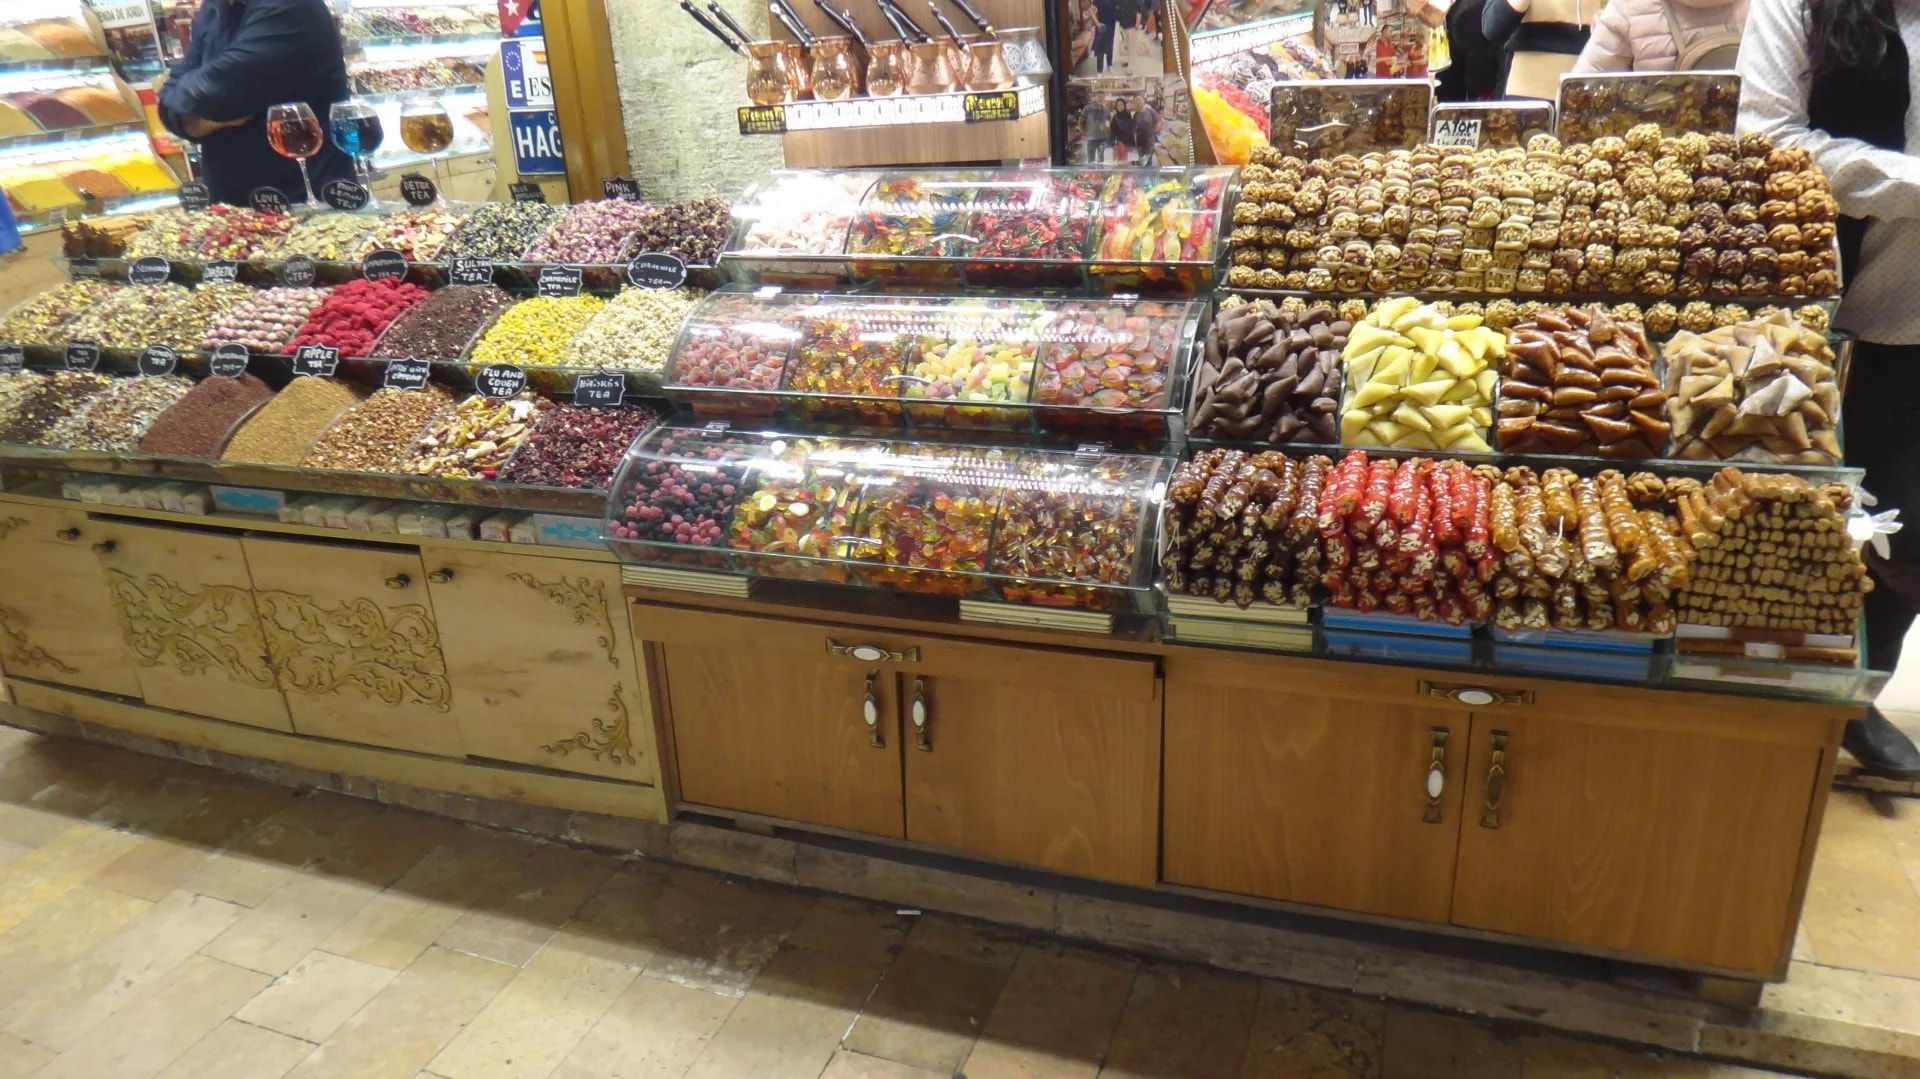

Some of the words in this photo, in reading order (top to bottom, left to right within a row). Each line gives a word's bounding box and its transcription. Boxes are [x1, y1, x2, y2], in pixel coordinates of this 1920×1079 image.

[510, 80, 523, 99] E
[1438, 121, 1478, 134] ATOM
[403, 180, 431, 191] DETOX
[604, 181, 631, 193] PINK
[254, 193, 280, 204] LOVE
[410, 190, 431, 200] TEA
[455, 259, 491, 272] SULTAN
[291, 271, 310, 283] TEA
[460, 271, 483, 283] TEA
[648, 277, 663, 286] TEA
[302, 348, 334, 360] APPLE
[482, 367, 500, 378] FLU
[501, 370, 524, 379] AND
[488, 377, 519, 388] COUGH
[491, 386, 513, 396] TEA
[588, 390, 611, 399] TEA
